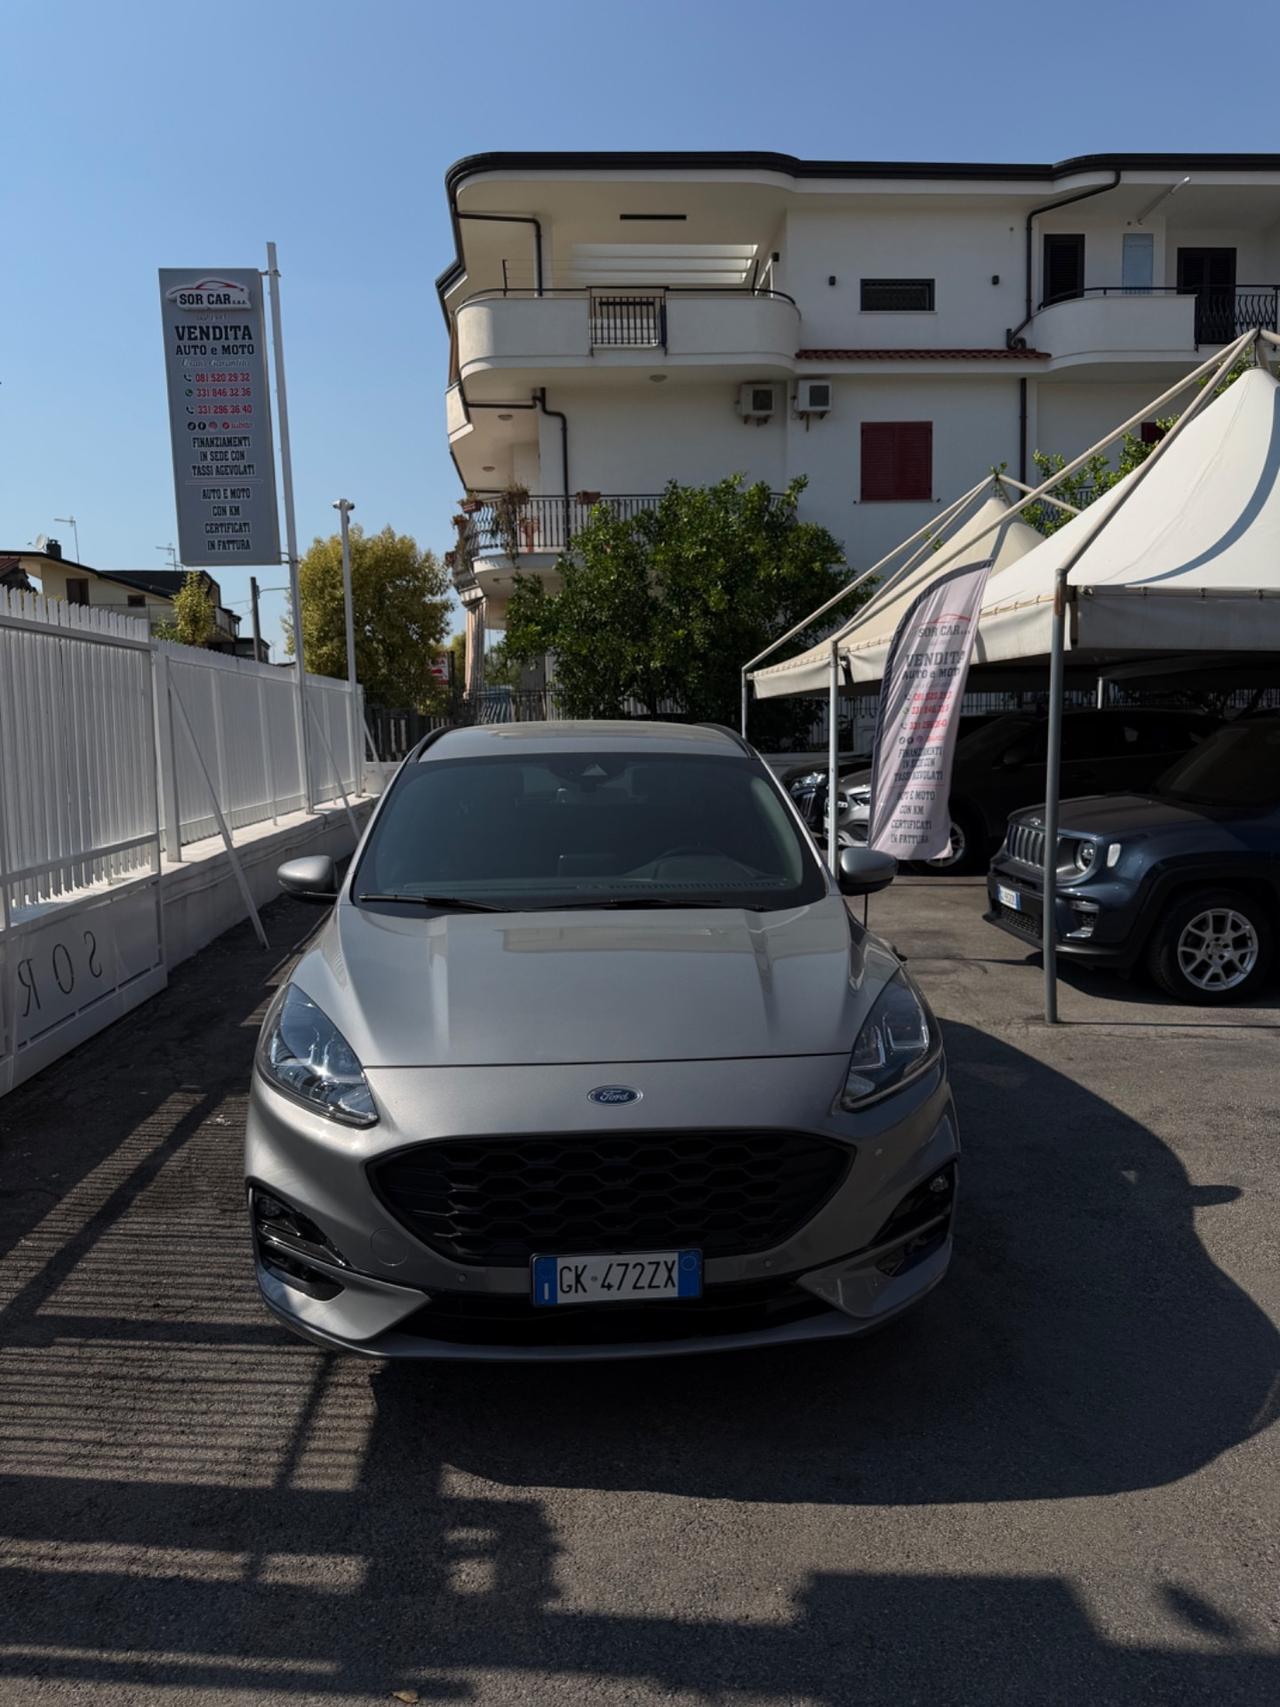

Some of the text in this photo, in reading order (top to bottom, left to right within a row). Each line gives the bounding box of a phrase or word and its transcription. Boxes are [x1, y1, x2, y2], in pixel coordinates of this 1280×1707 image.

[179, 293, 204, 305] SOR
[174, 325, 253, 341] VENDITA
[175, 343, 255, 356] AUTO e MOTO
[192, 436, 251, 448] FINANZIAMENTI
[200, 450, 245, 461] IN SEDE CON
[192, 464, 255, 476] TASSI AGEVOLATI
[202, 487, 251, 499] AUTO E MOTO
[212, 505, 241, 516] CON KM
[205, 522, 251, 533] CERTIFICATI
[207, 539, 251, 550] IN FATTURA
[600, 1089, 630, 1102] Ford
